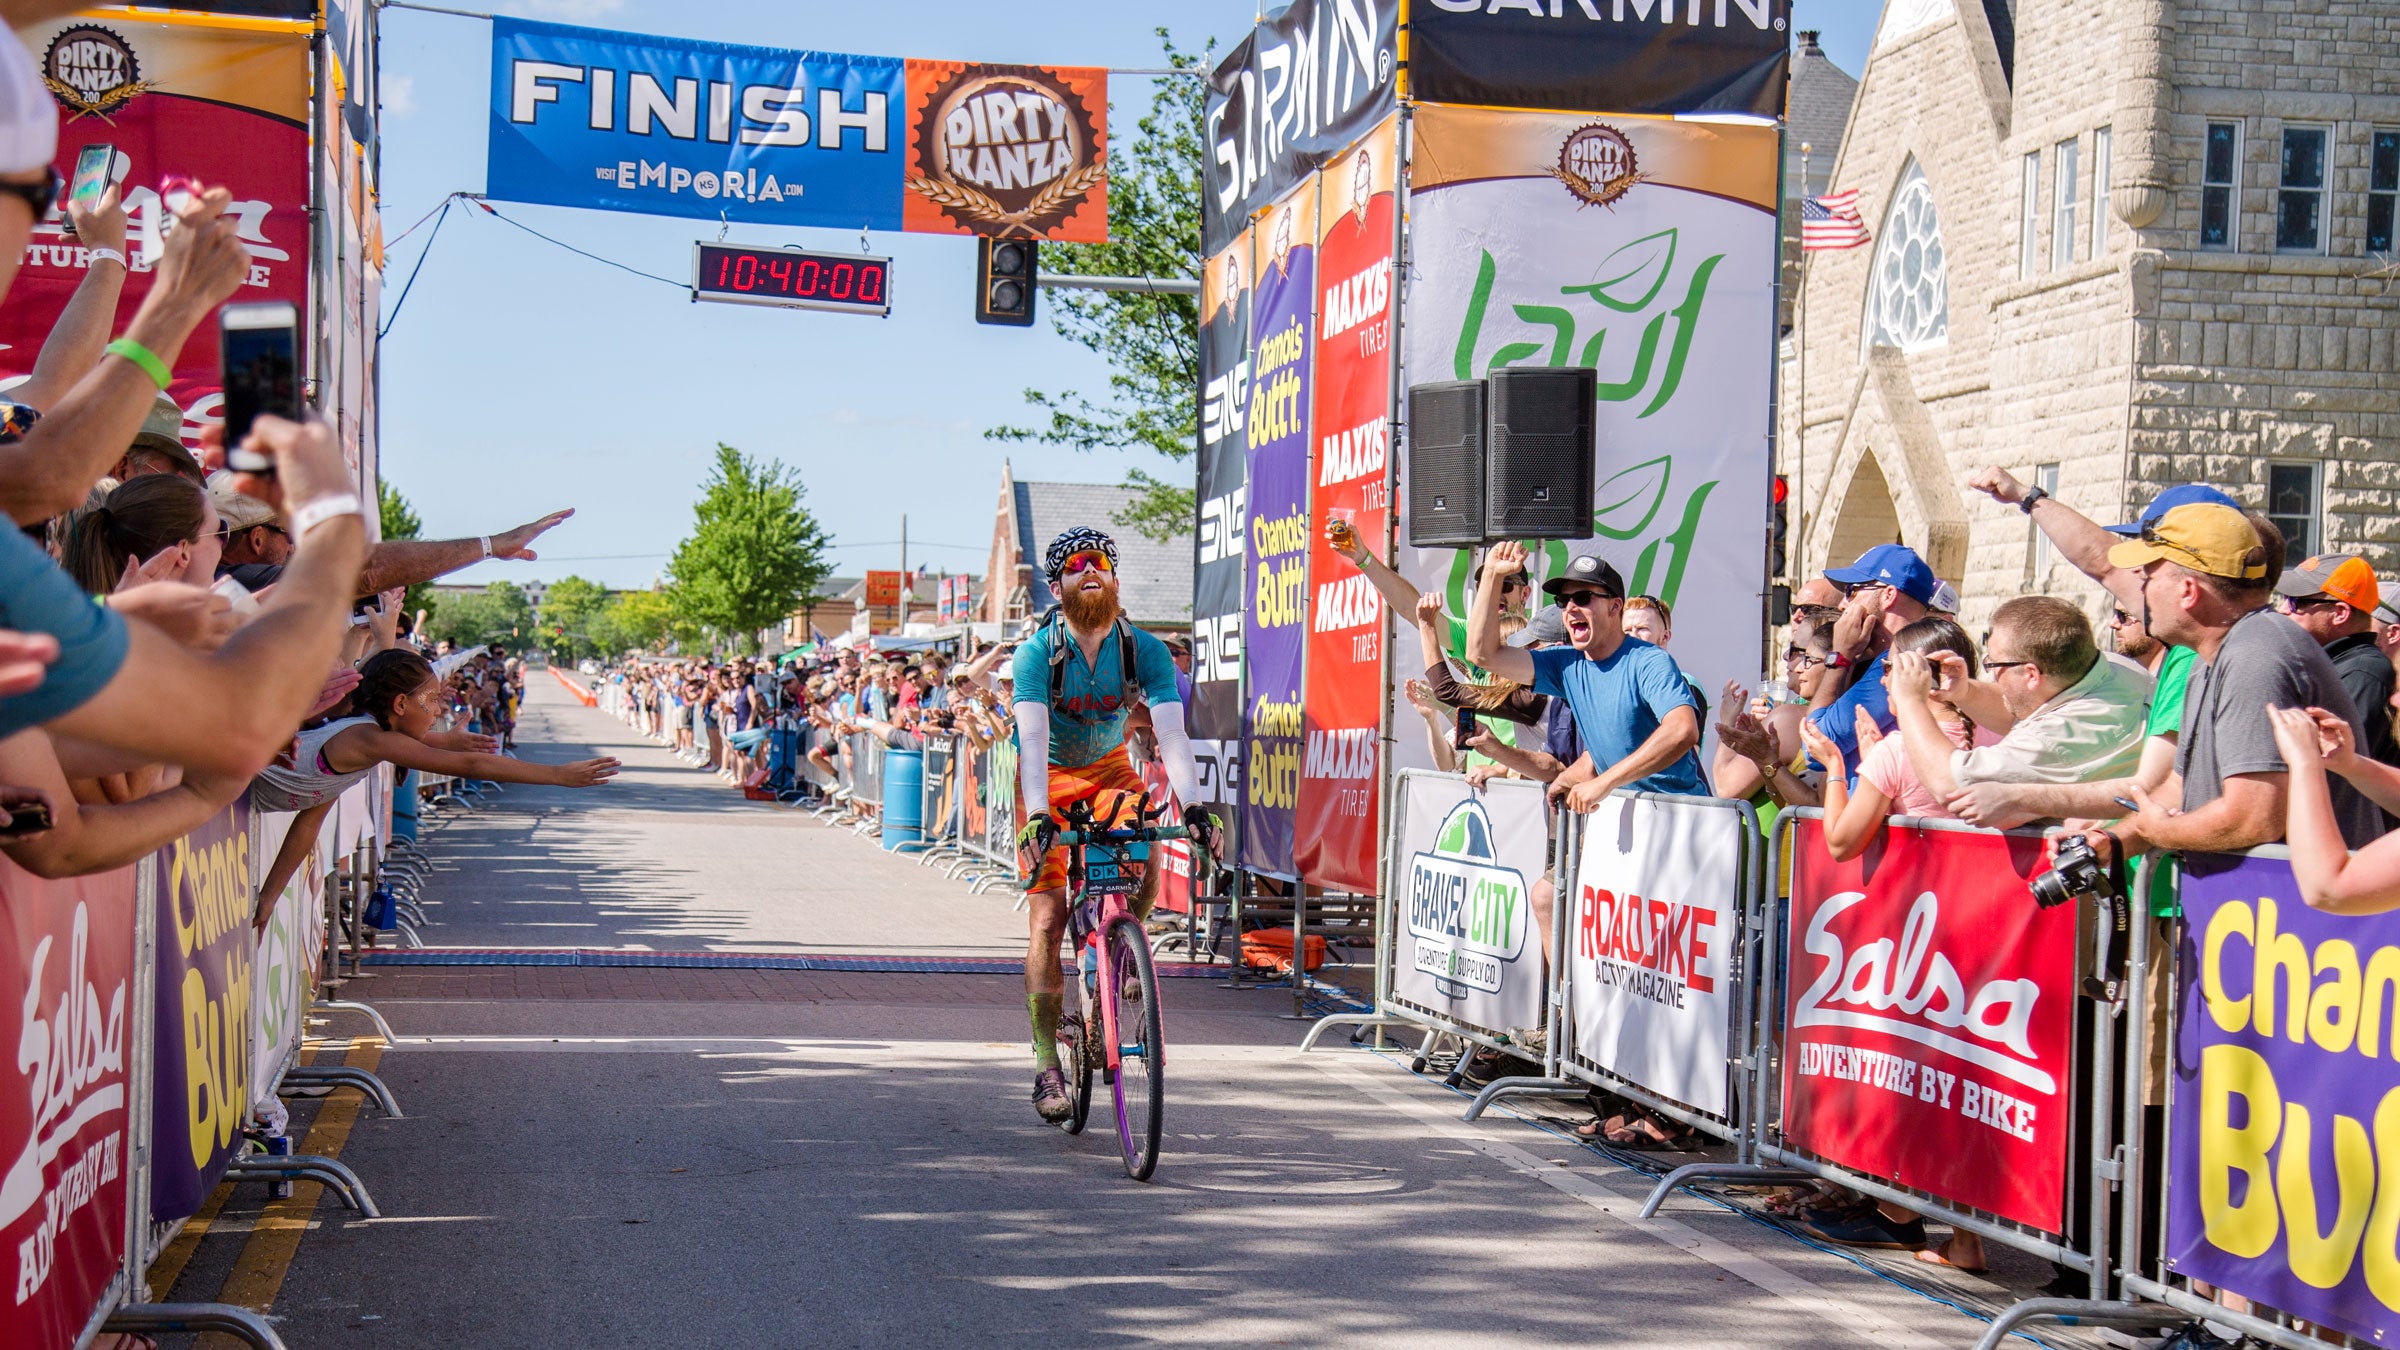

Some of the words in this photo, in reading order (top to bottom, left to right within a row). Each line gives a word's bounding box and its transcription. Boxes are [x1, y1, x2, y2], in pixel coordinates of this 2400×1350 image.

[57, 40, 125, 71] DIRTY
[58, 63, 125, 92] KANZA
[83, 91, 100, 104] 200
[510, 57, 888, 153] FINISH
[945, 90, 1067, 148] DIRTY
[949, 139, 1074, 191] KANZA
[1570, 137, 1627, 162] DIRTY
[1570, 160, 1627, 183] KANZA
[596, 167, 617, 181] VISIT
[1590, 183, 1604, 194] 200
[718, 254, 881, 303] 10:40:00
[1322, 257, 1390, 341] MAXXIS
[1256, 314, 1303, 380] Chamois
[1360, 319, 1388, 359] TIRES
[1320, 415, 1385, 487] MAXXIS
[1253, 503, 1305, 559] Chamois
[1315, 573, 1379, 633] MAXXIS
[1353, 632, 1377, 664] TIRES
[1254, 690, 1301, 738] Chamois
[1304, 728, 1376, 780] MAXXIS
[1340, 789, 1369, 817] TIRES
[1174, 856, 1189, 878] BIK
[1412, 864, 1467, 939] GRAVEL
[1471, 878, 1518, 949] CITY
[2115, 894, 2127, 931] Canon
[1457, 955, 1484, 983] SUPPLY
[1629, 968, 1686, 1010] MAGAZINE
[1793, 891, 2041, 1060] Salsa
[0, 900, 126, 1205] Salsa
[1799, 1043, 1917, 1096] ADVENTURE
[1919, 1065, 1956, 1109] BY
[1961, 1078, 2036, 1143] BIKE
[100, 1130, 120, 1186] BIK
